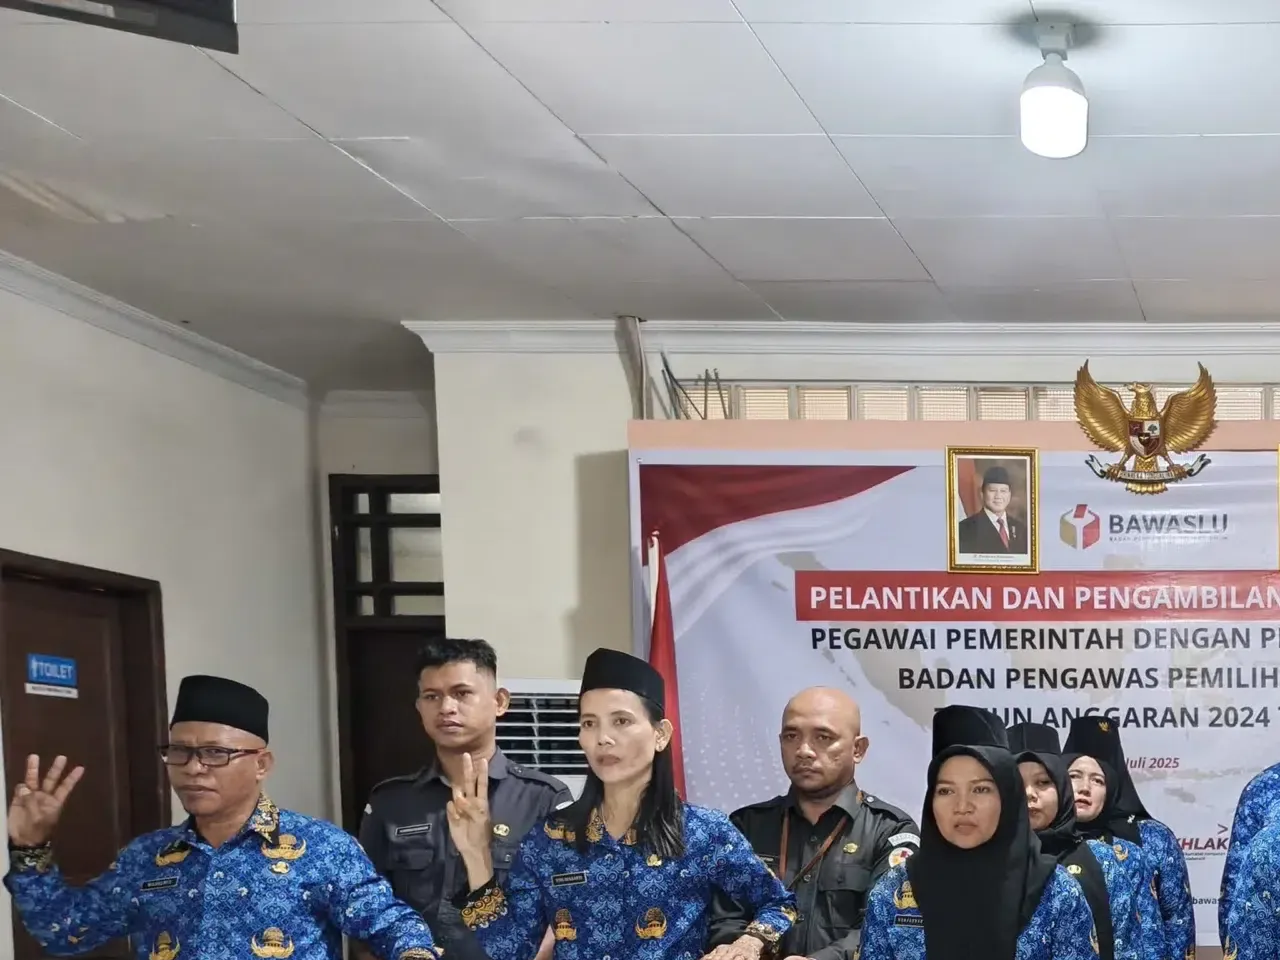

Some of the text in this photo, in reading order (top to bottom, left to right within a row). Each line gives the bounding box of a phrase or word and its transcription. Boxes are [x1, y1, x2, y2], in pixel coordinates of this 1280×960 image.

[1109, 514, 1228, 534] BAWASLU
[810, 587, 992, 610] PELANTIKAN
[1002, 587, 1064, 609] DAN
[811, 628, 936, 650] PEGAWAI
[947, 628, 1123, 650] PEMERINTAH
[1134, 627, 1251, 650] DENGAN
[37, 662, 73, 679] TOILET
[899, 668, 995, 689] BADAN
[1006, 667, 1159, 689] PENGAWAS
[1208, 706, 1270, 728] 2024
[1149, 757, 1180, 769] 2025
